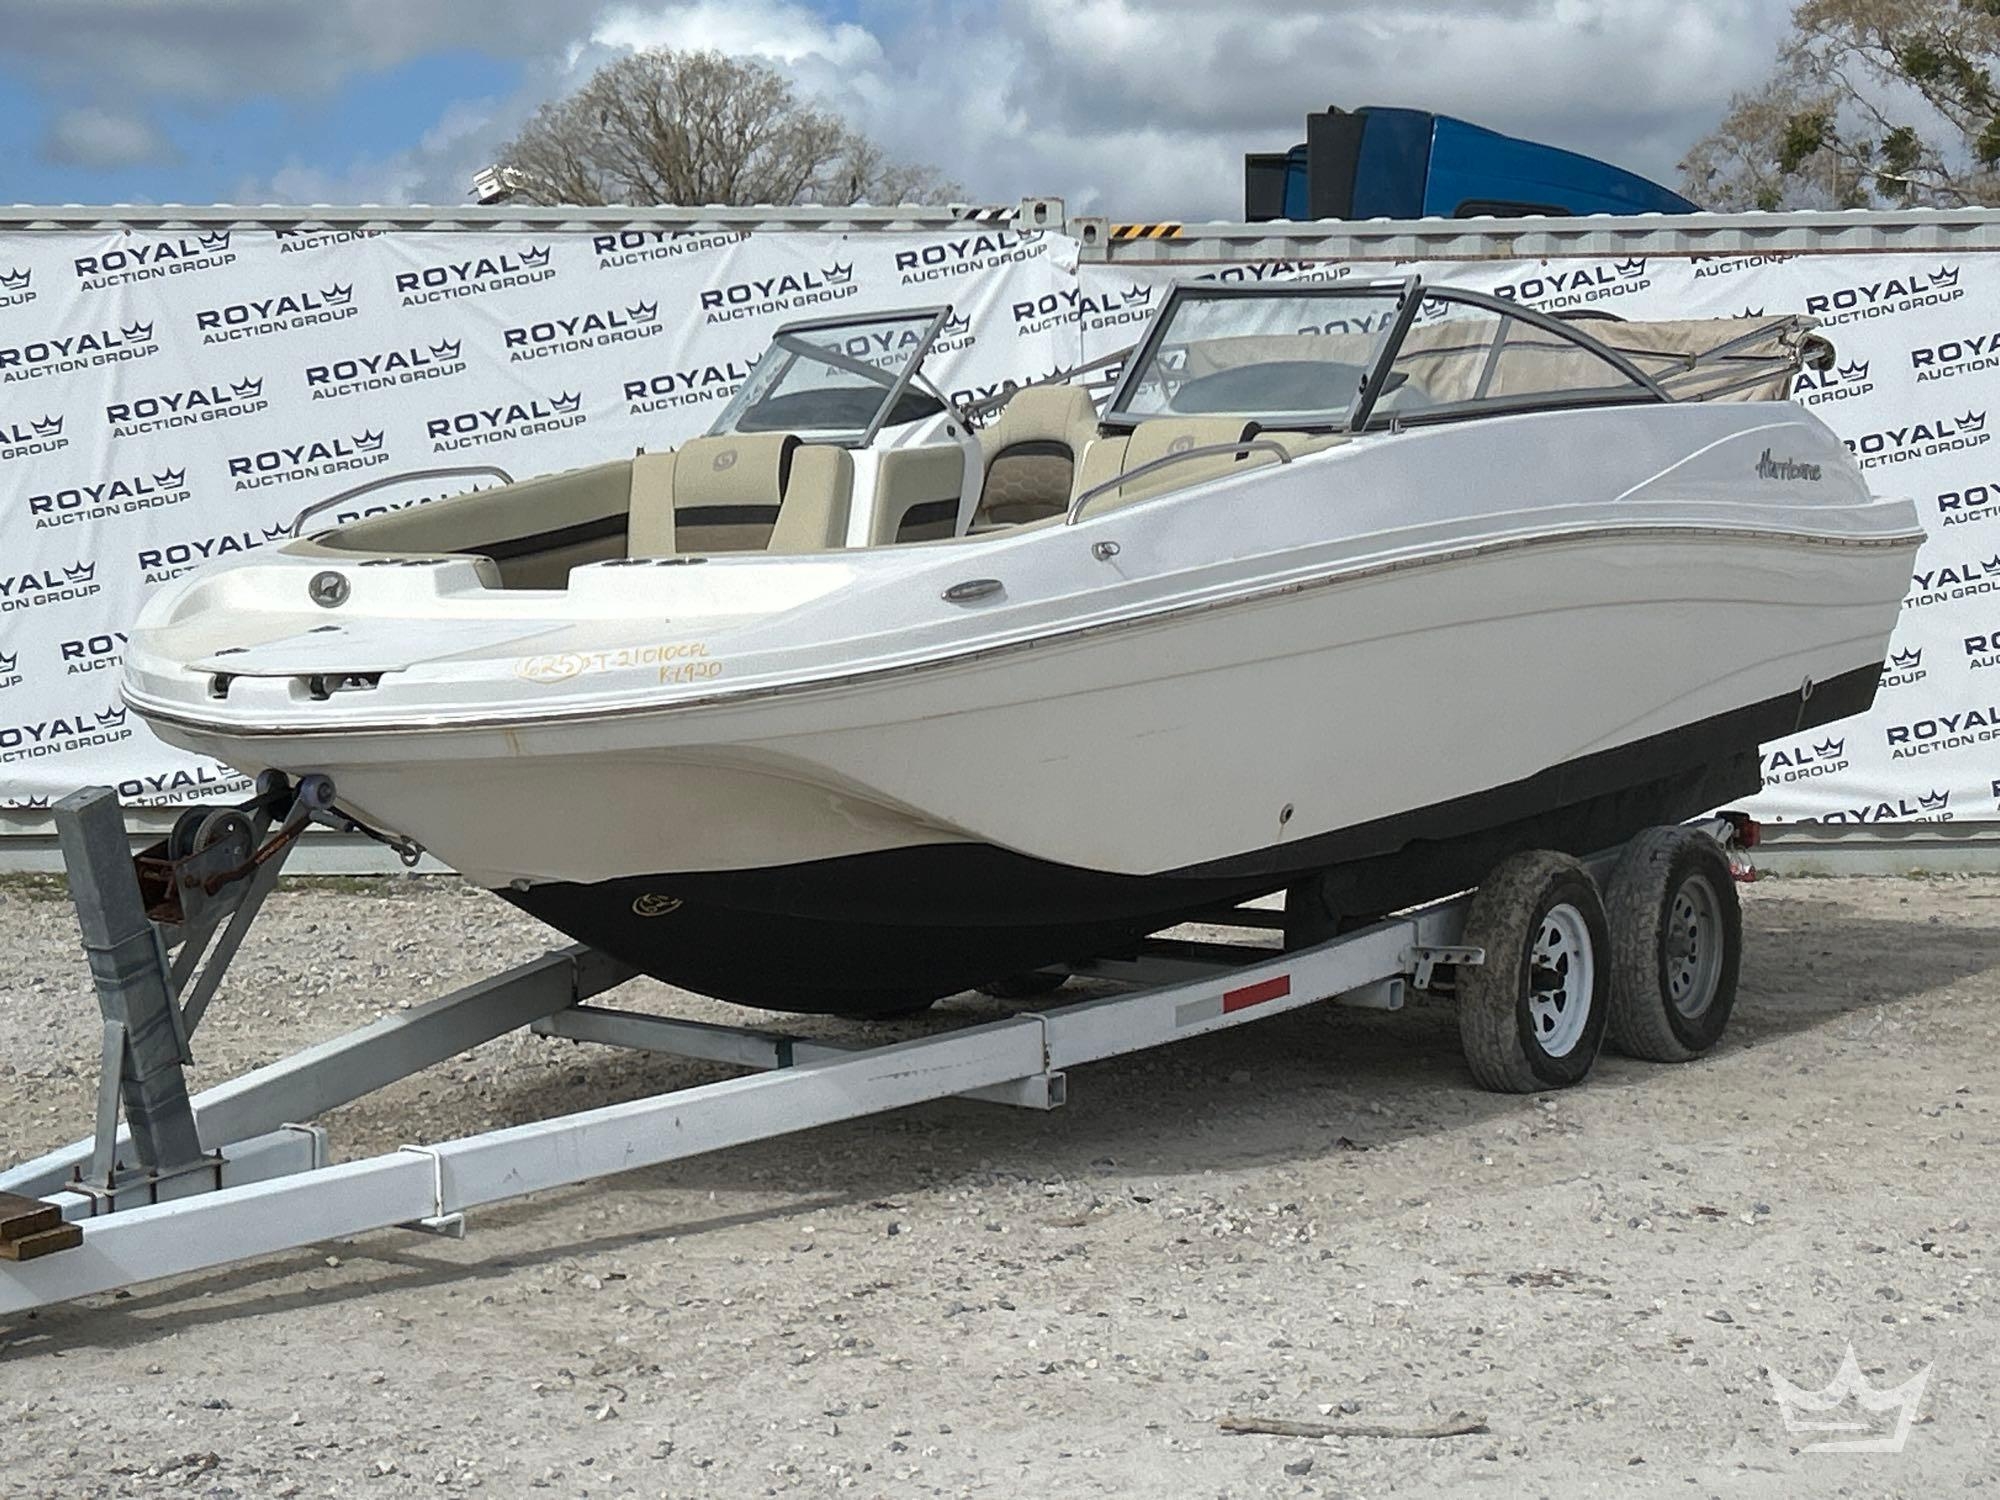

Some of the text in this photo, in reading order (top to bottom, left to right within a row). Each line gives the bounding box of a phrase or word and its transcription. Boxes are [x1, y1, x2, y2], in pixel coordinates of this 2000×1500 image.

[75, 239, 199, 277] ROYAL
[599, 244, 683, 270] AUCTION
[895, 231, 1018, 271] ROYAL
[901, 244, 1048, 286] AUCTION GROUP
[81, 254, 236, 292] AUCTION GROUP
[396, 255, 519, 293] ROYAL
[402, 269, 556, 307] AUCTION GROUP
[701, 271, 822, 310] ROYAL
[1585, 279, 1651, 301] GROUP
[0, 292, 37, 307] OUP
[197, 292, 322, 330] ROYAL
[706, 286, 858, 324] AUCTION GROUP
[1013, 288, 1122, 322] ROYAL
[1806, 276, 1929, 315] ROYAL
[1899, 289, 1964, 312] GROUP
[202, 306, 358, 345] AUCTION GROUP
[504, 310, 627, 347] ROYAL
[510, 324, 663, 363] AUCTION GROUP
[0, 331, 122, 368] ROYAL
[3, 344, 159, 383] AUCTION GROUP
[306, 348, 430, 386] ROYAL
[312, 362, 466, 400] AUCTION GROUP
[623, 362, 746, 400] ROYAL
[1916, 357, 1999, 382] AUCTION
[106, 386, 231, 423] ROYAL
[629, 390, 712, 415] AUCTION
[1808, 383, 1874, 405] GROUP
[112, 400, 268, 439] AUCTION GROUP
[427, 400, 550, 439] ROYAL
[433, 415, 586, 453] AUCTION GROUP
[2, 438, 69, 460] GROUP
[228, 439, 353, 477] ROYAL
[1859, 433, 1990, 470] CTION GROUP
[234, 453, 389, 491] AUCTION GROUP
[29, 477, 154, 515] ROYAL
[35, 491, 191, 530] AUCTION GROUP
[1943, 505, 2000, 527] AUCTI
[138, 532, 263, 570] ROYAL
[0, 570, 64, 597] YAL
[33, 584, 101, 605] GROUP
[1913, 564, 1981, 590] YAL
[1904, 592, 1948, 608] TION
[67, 655, 122, 675] AUCTI
[1878, 670, 1926, 688] ROUP
[0, 716, 96, 748] OYAL
[0, 729, 132, 763] CTION GROUP
[1892, 734, 1974, 759] AUCTION
[118, 767, 216, 797] OYAL
[187, 779, 253, 800] GROUP
[1785, 760, 1848, 782] GROUP
